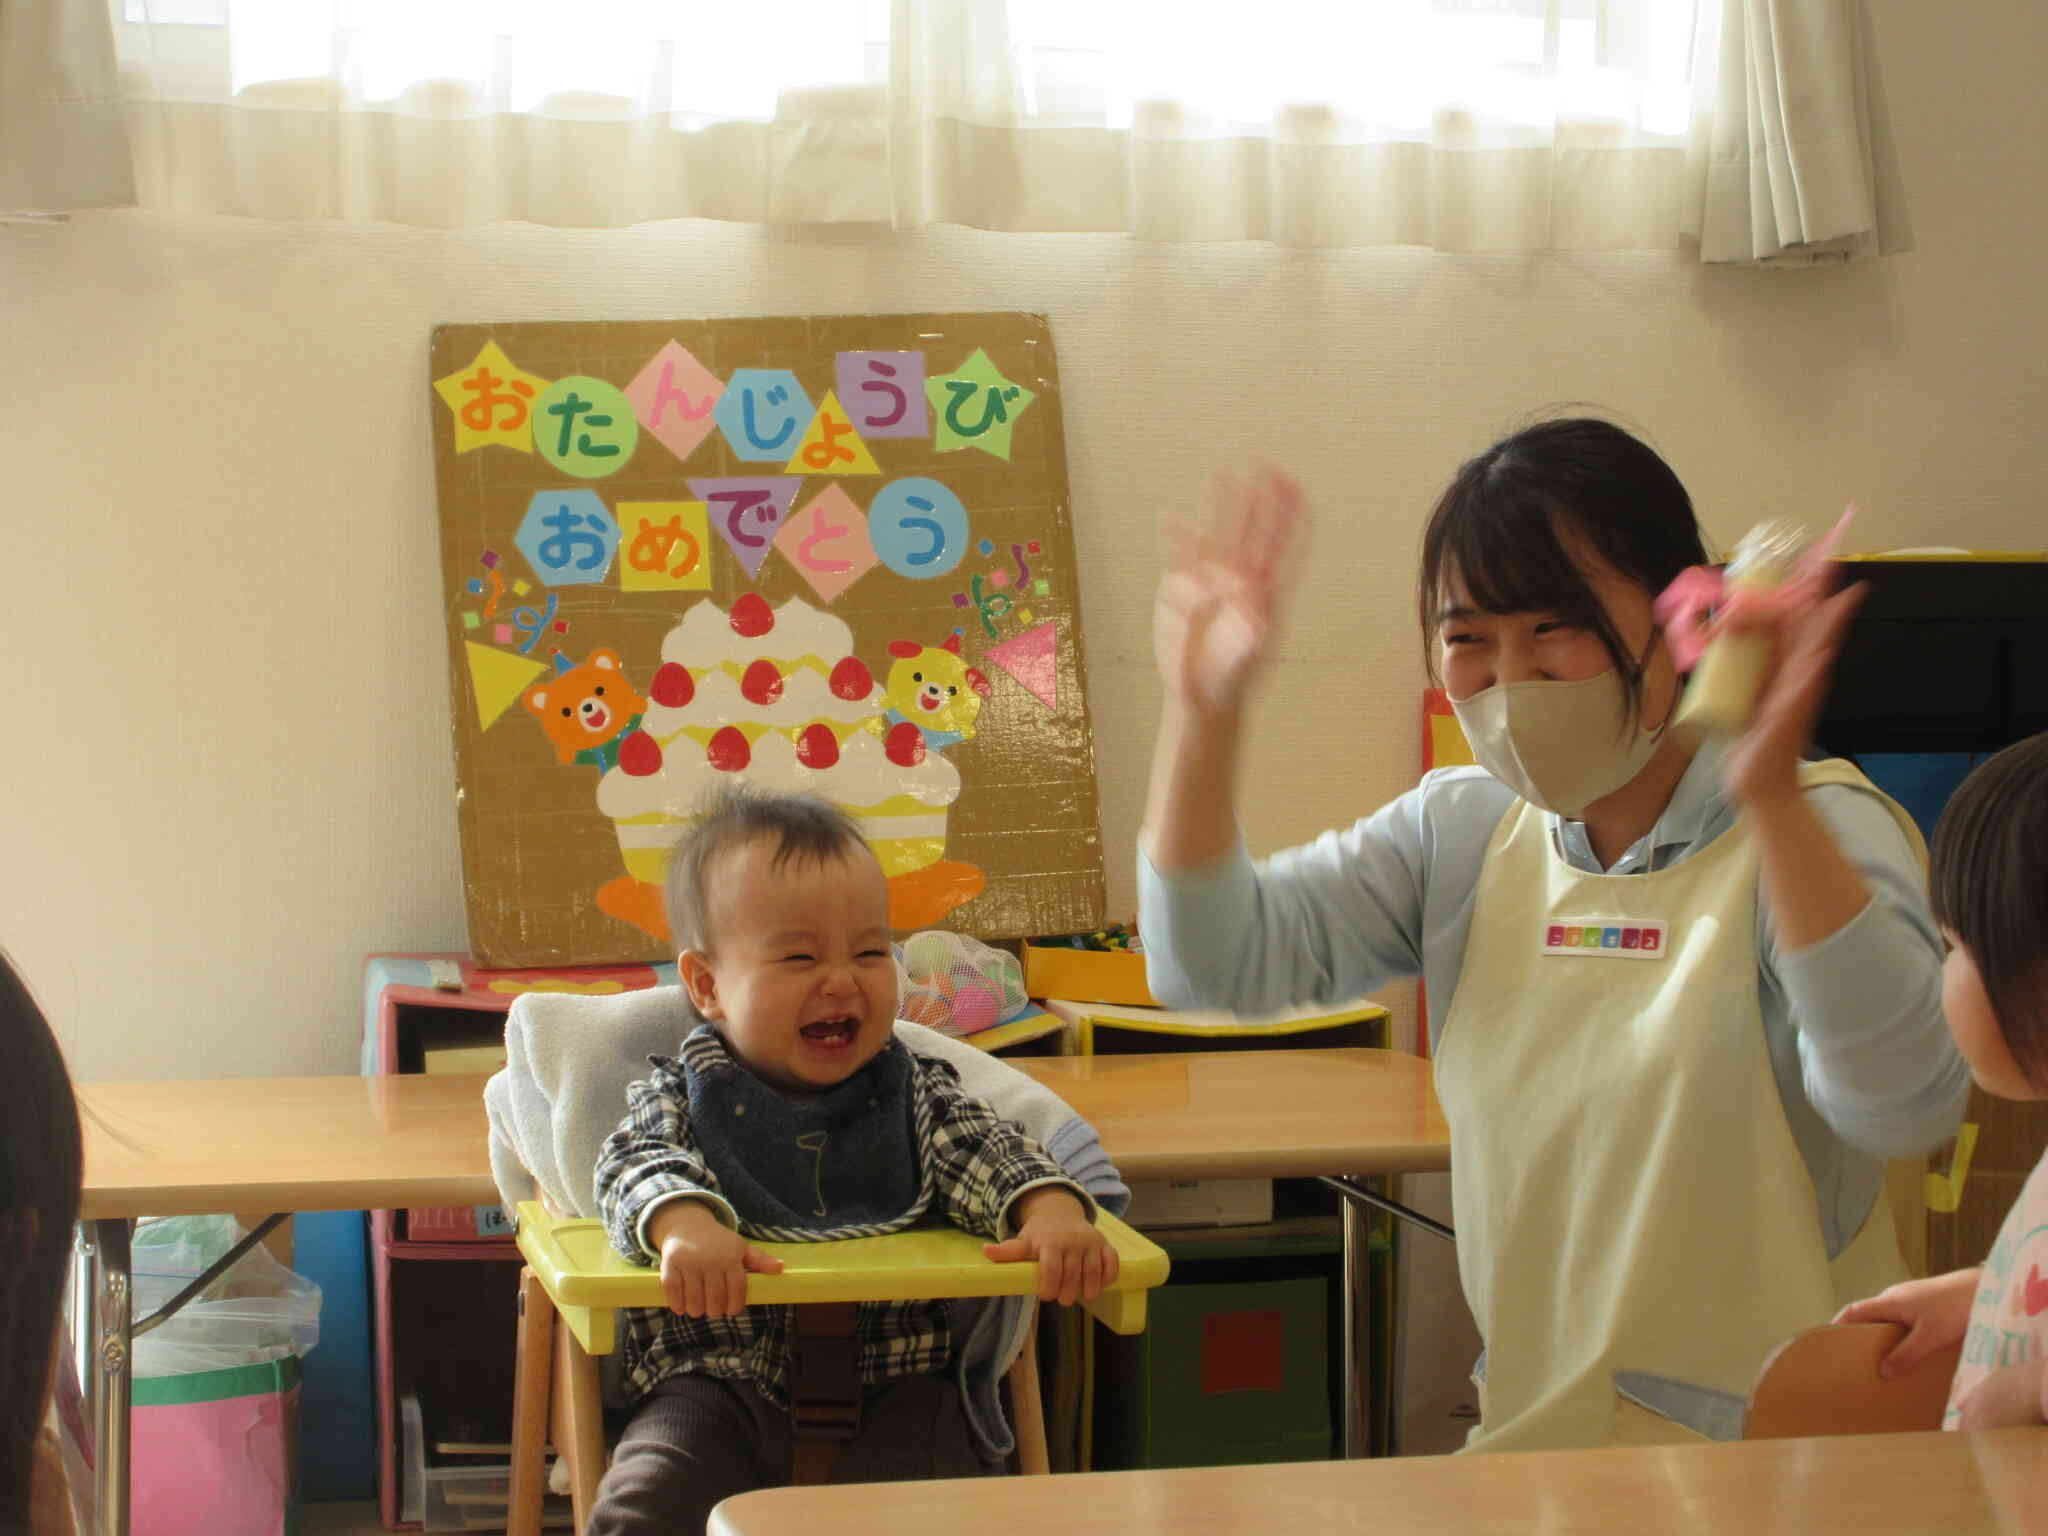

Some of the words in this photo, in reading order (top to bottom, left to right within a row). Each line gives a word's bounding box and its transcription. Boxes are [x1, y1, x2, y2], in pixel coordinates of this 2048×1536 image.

[461, 360, 1020, 468] おたんじょうび
[538, 490, 946, 579] おめでとう
